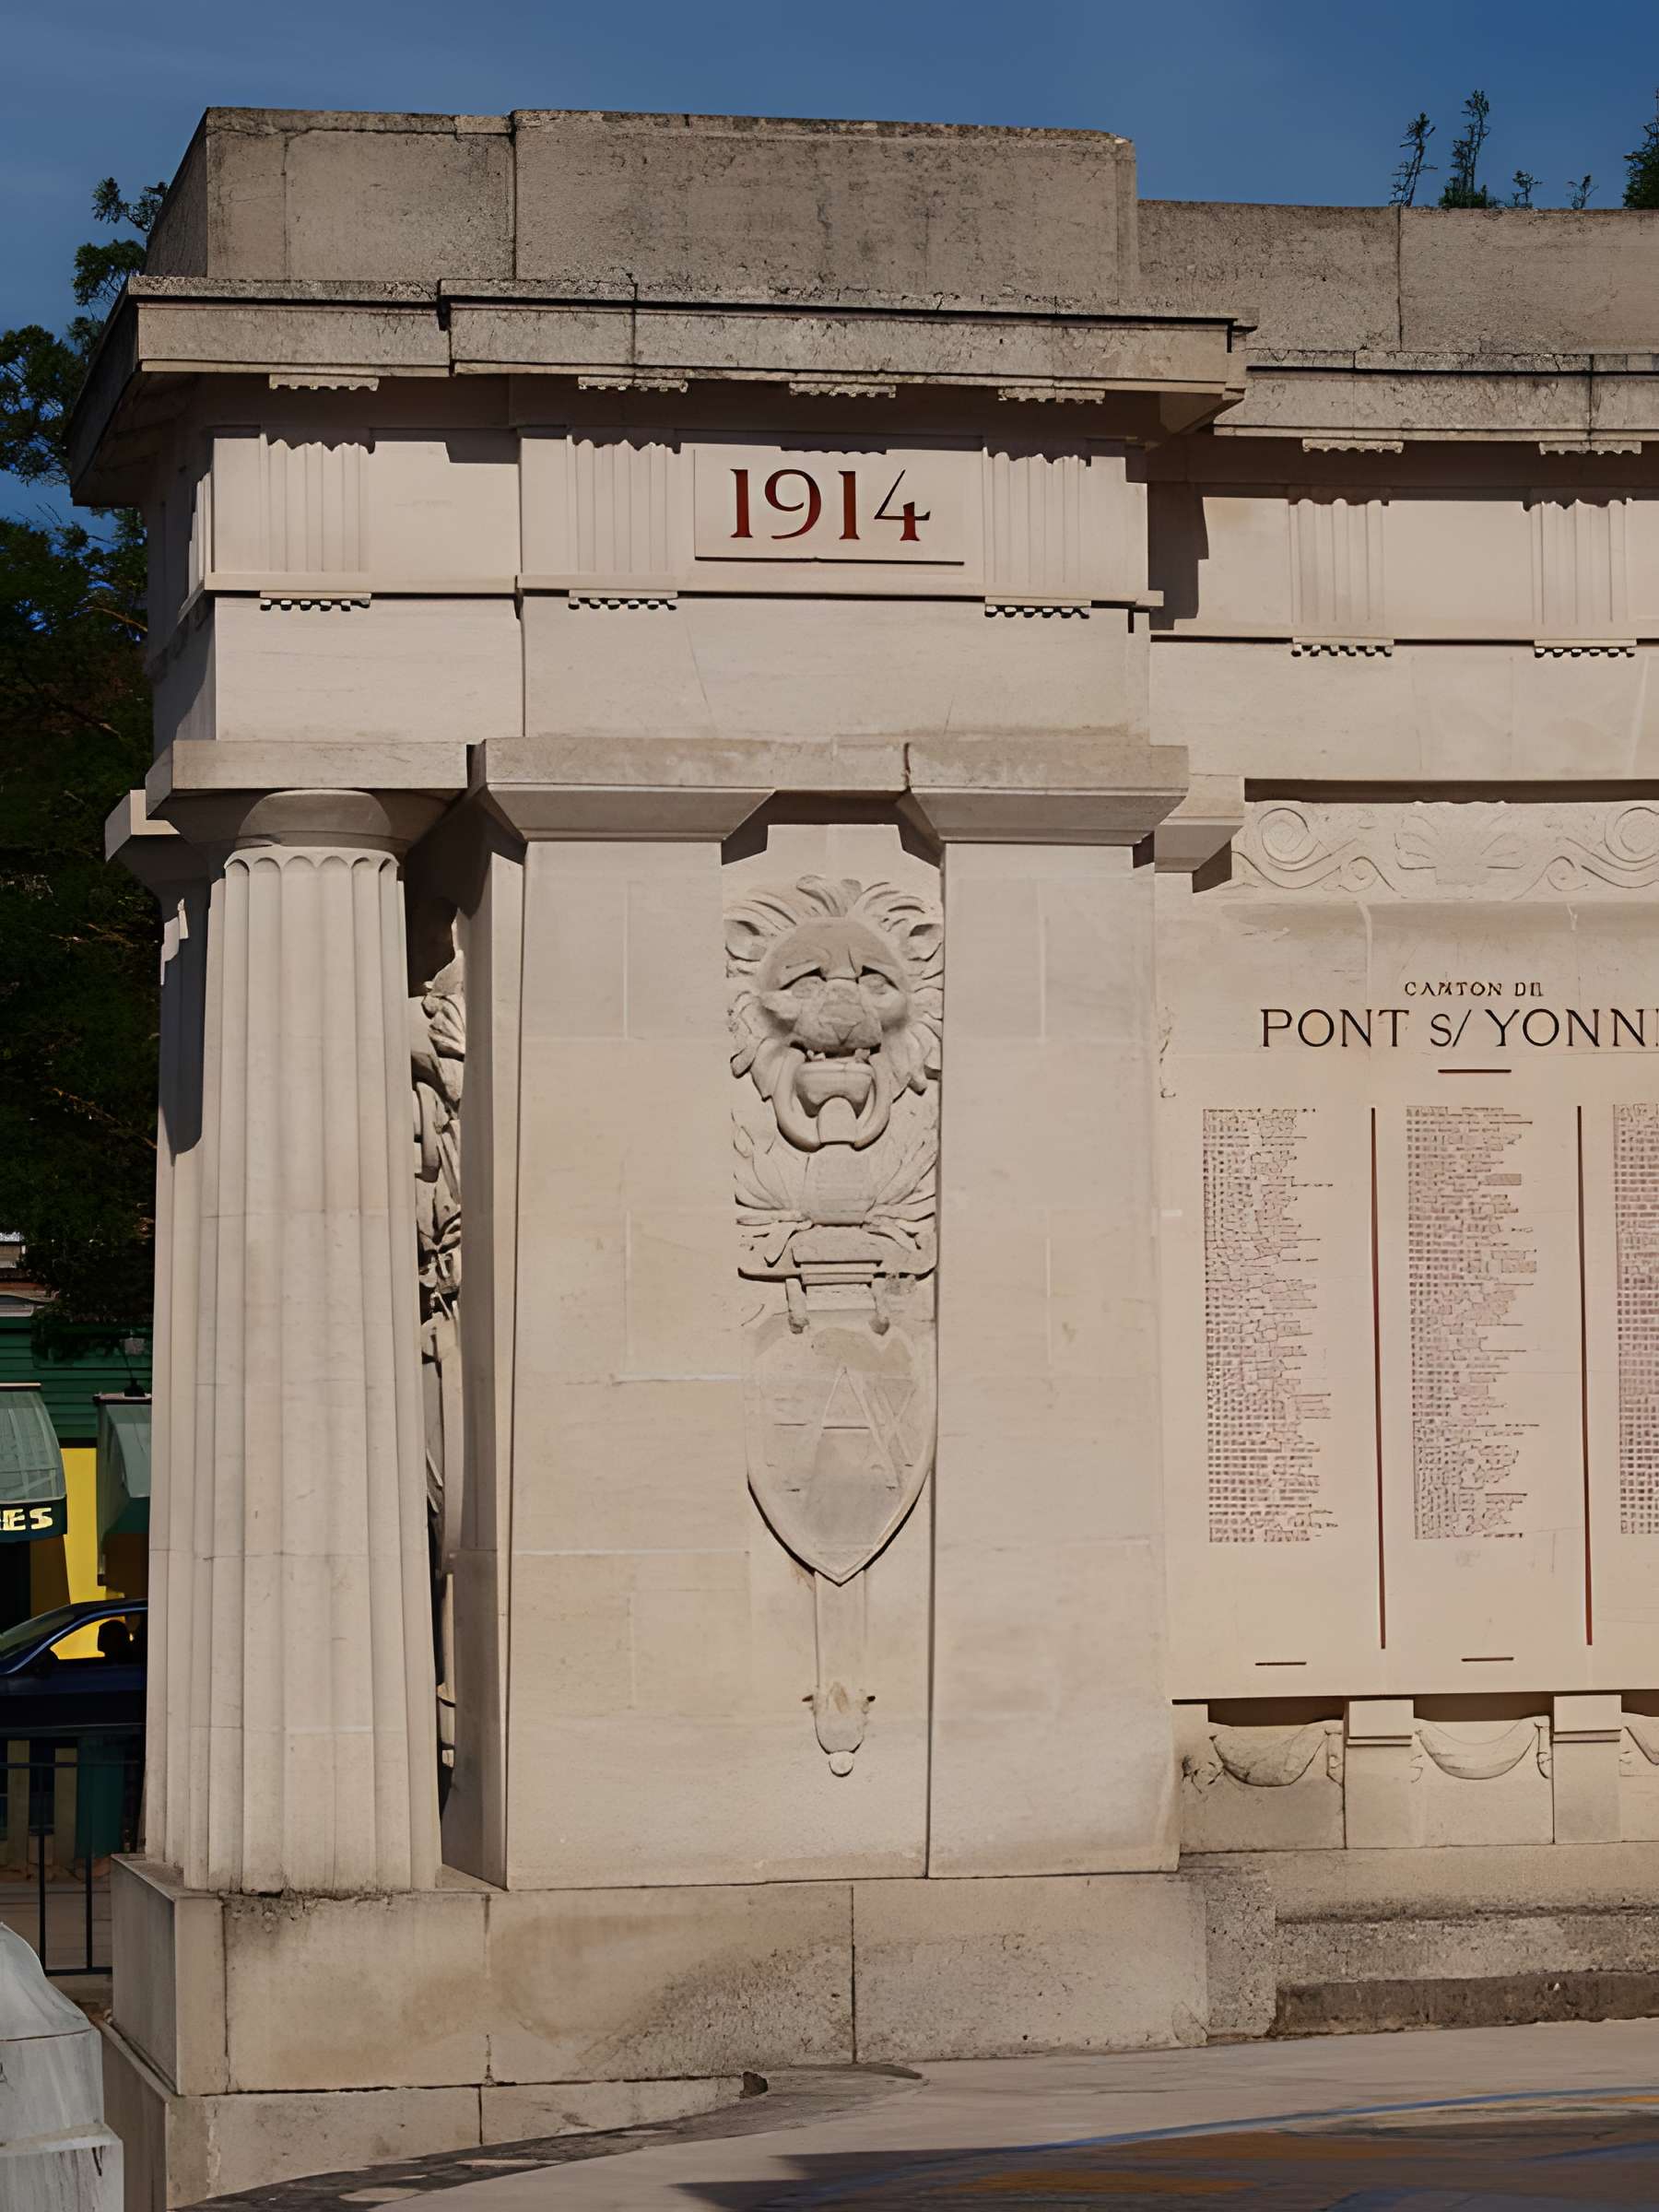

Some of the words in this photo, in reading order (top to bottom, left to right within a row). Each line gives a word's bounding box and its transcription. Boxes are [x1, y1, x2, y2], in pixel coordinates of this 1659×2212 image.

[730, 468, 931, 542] 1914
[1260, 1008, 1410, 1048] PONT
[1430, 1008, 1659, 1048] S/YONN
[0, 1507, 53, 1531] ES
